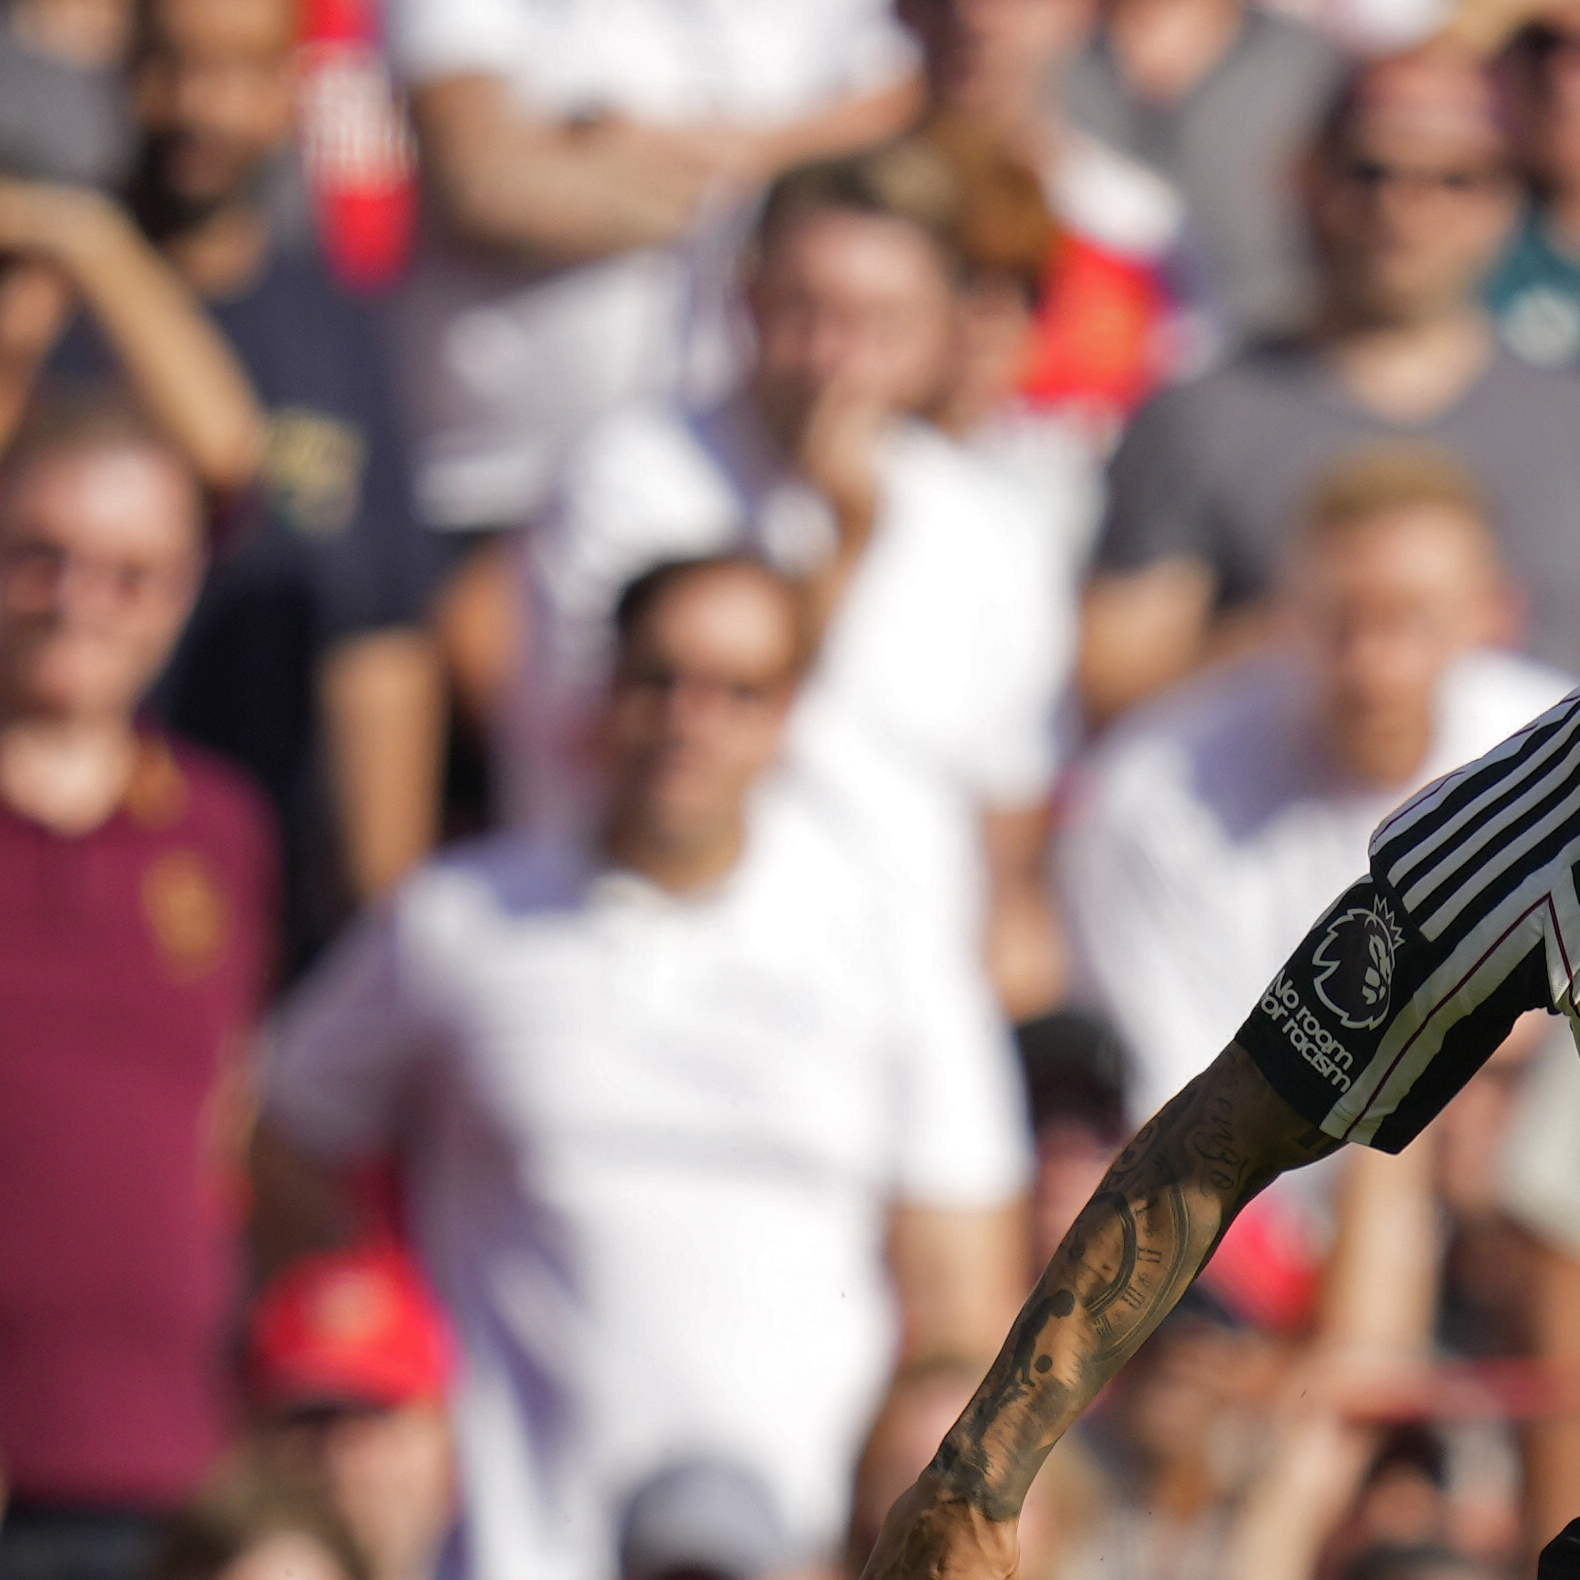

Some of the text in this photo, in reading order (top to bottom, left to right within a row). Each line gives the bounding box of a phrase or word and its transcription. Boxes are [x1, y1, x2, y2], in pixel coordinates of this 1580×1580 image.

[1269, 968, 1353, 1070] No room
[1281, 1019, 1351, 1094] racism
